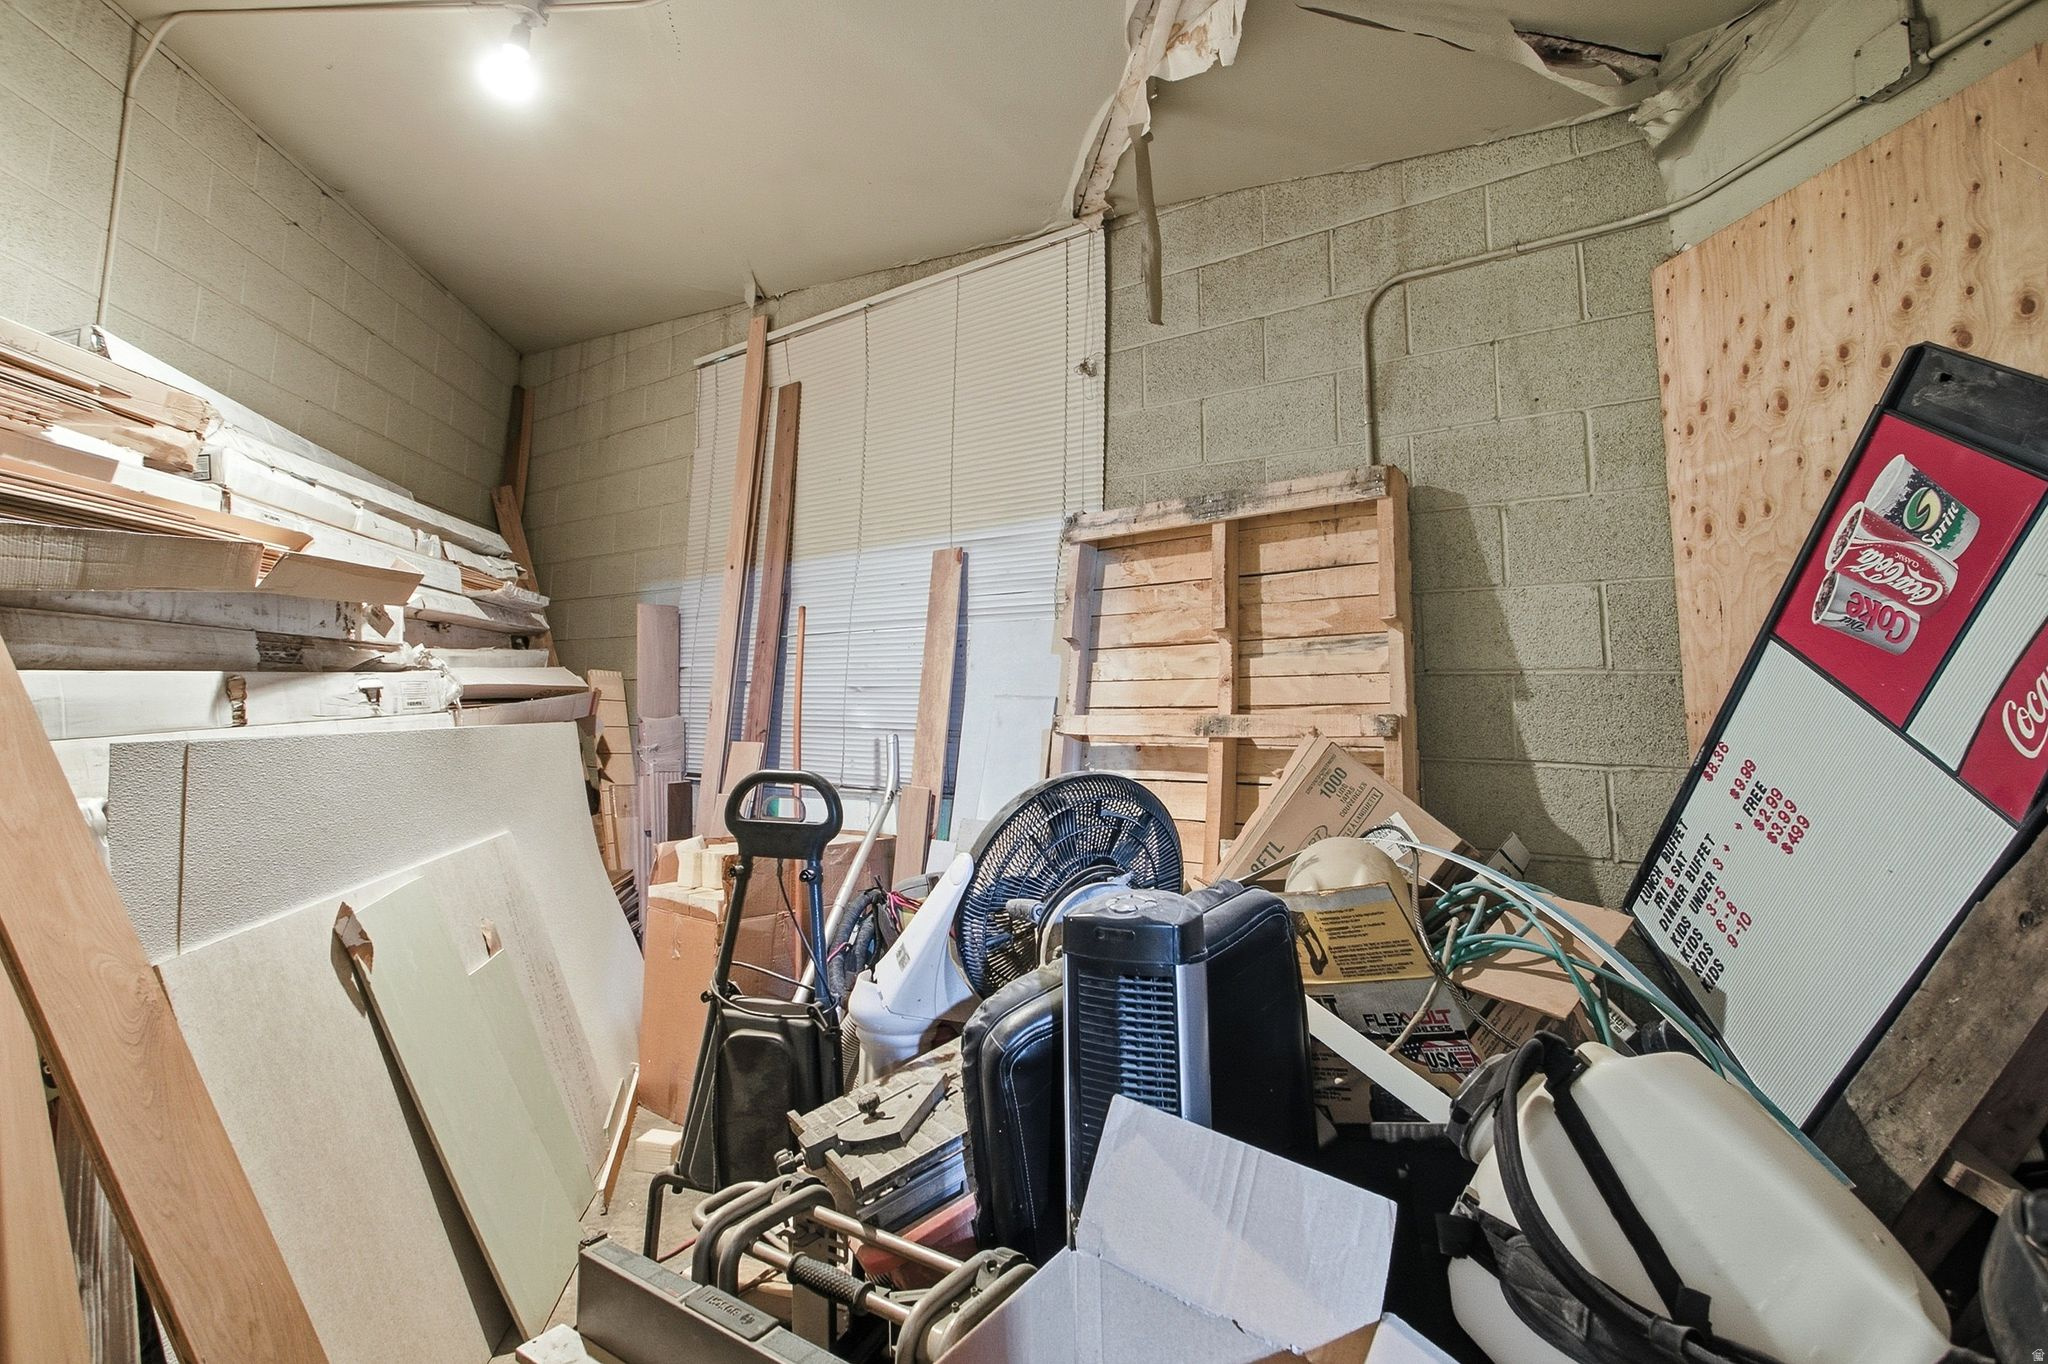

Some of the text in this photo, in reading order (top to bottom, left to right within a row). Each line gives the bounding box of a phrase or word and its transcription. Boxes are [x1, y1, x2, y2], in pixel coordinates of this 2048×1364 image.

[1894, 551, 1920, 569] CLASSIC
[1921, 502, 1960, 547] Sprite
[1845, 592, 1911, 644] Coke
[1320, 767, 1347, 799] 1000
[1639, 741, 1729, 906] LUNCH BUFFET $8.36
[1653, 850, 1689, 911] FRI & SAT
[1658, 759, 1757, 933] DINNER BUFFET $9.99
[1670, 780, 1768, 949] KIDS UNDER 3 FREE
[1680, 927, 1704, 964] KIDS
[1753, 787, 1783, 831] $2.99
[1690, 799, 1797, 978] KIDS 6-8 $3.99
[1700, 815, 1810, 994] KIDS 9-10 $499
[1425, 1051, 1461, 1069] USA
